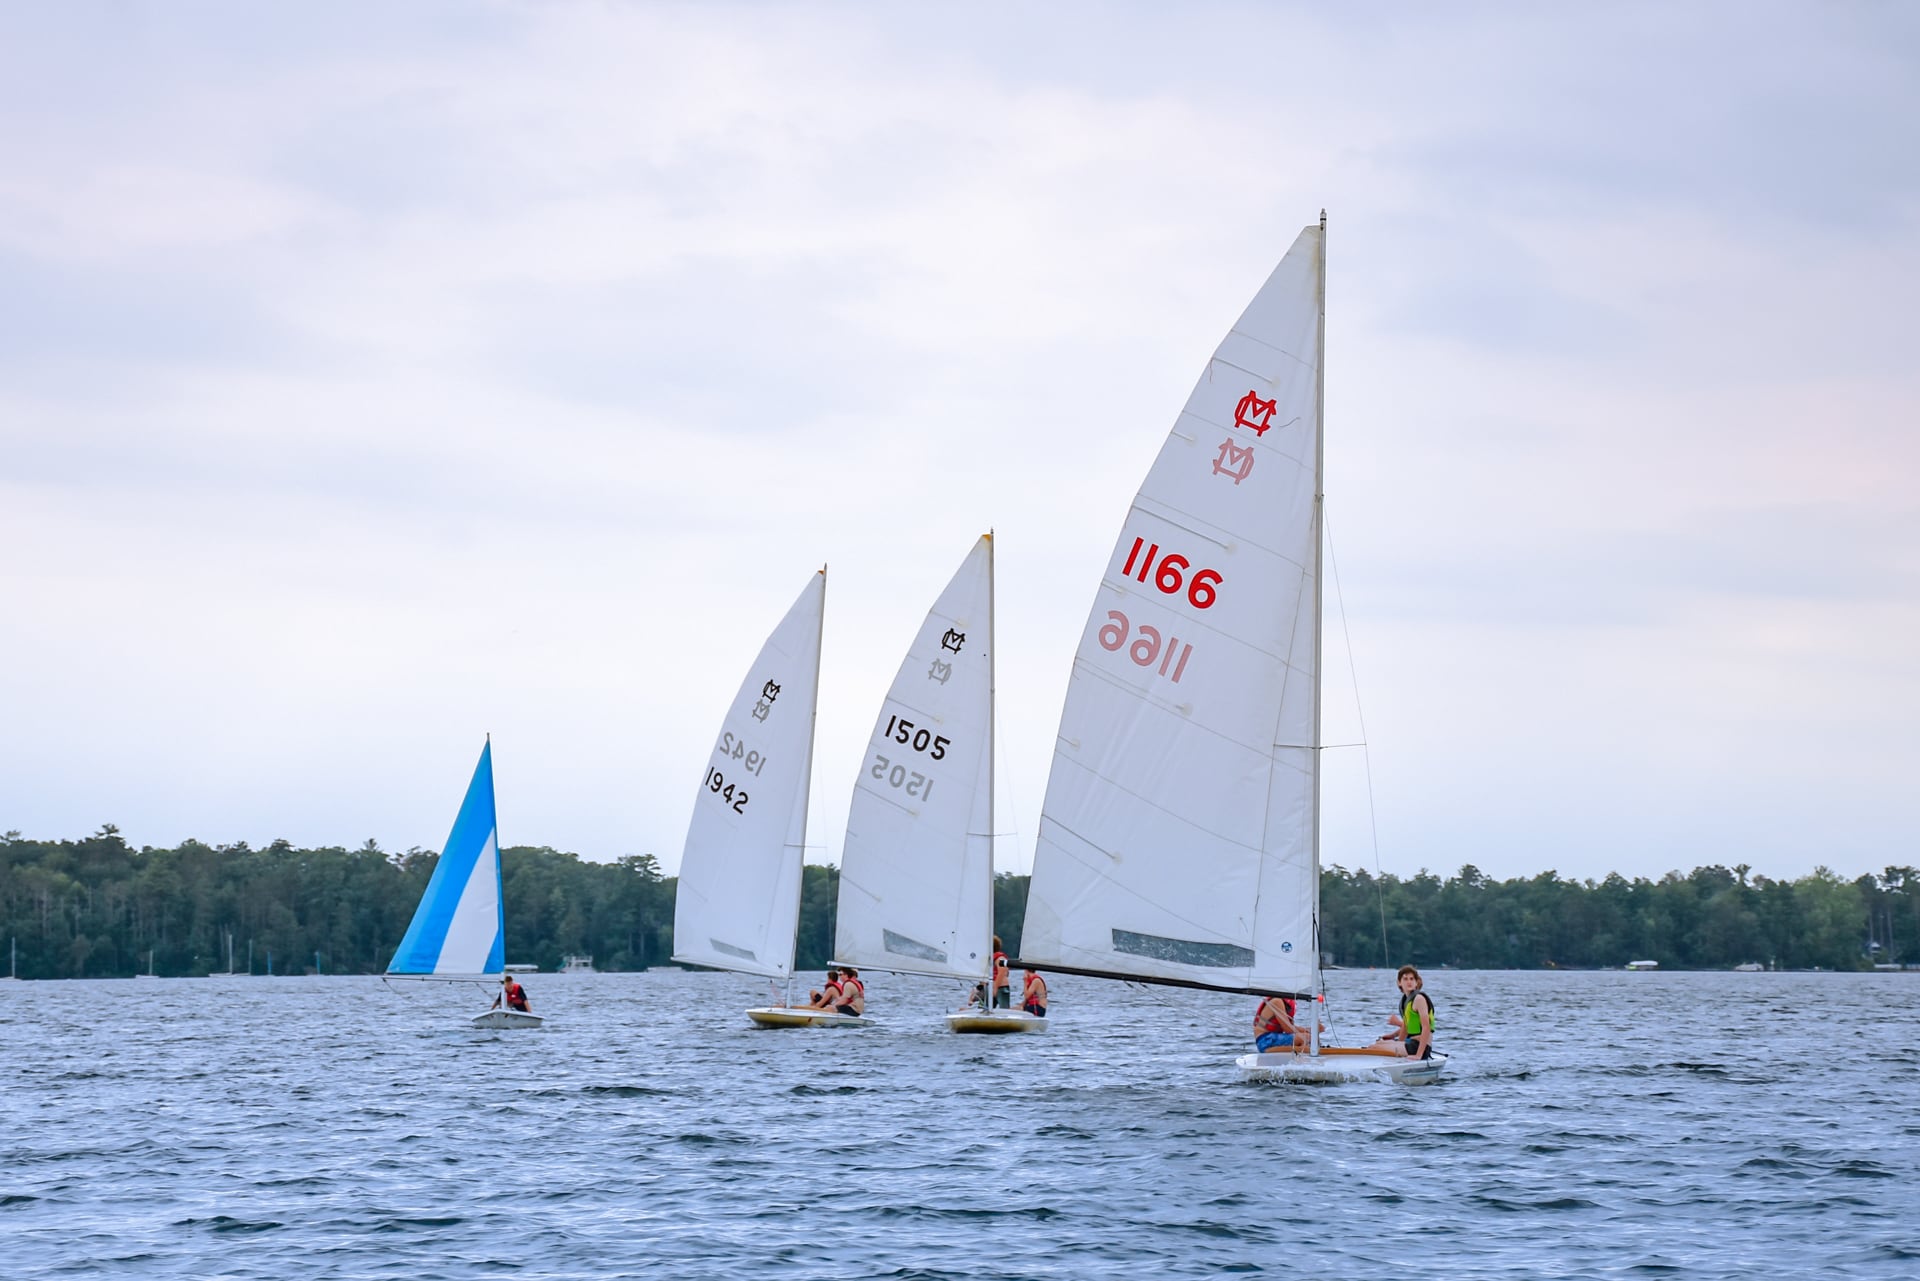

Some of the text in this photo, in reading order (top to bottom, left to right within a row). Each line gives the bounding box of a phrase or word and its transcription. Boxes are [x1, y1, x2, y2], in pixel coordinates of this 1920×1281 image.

[1121, 536, 1224, 610] 1166
[884, 714, 952, 762] 1505
[705, 766, 749, 815] 1942
